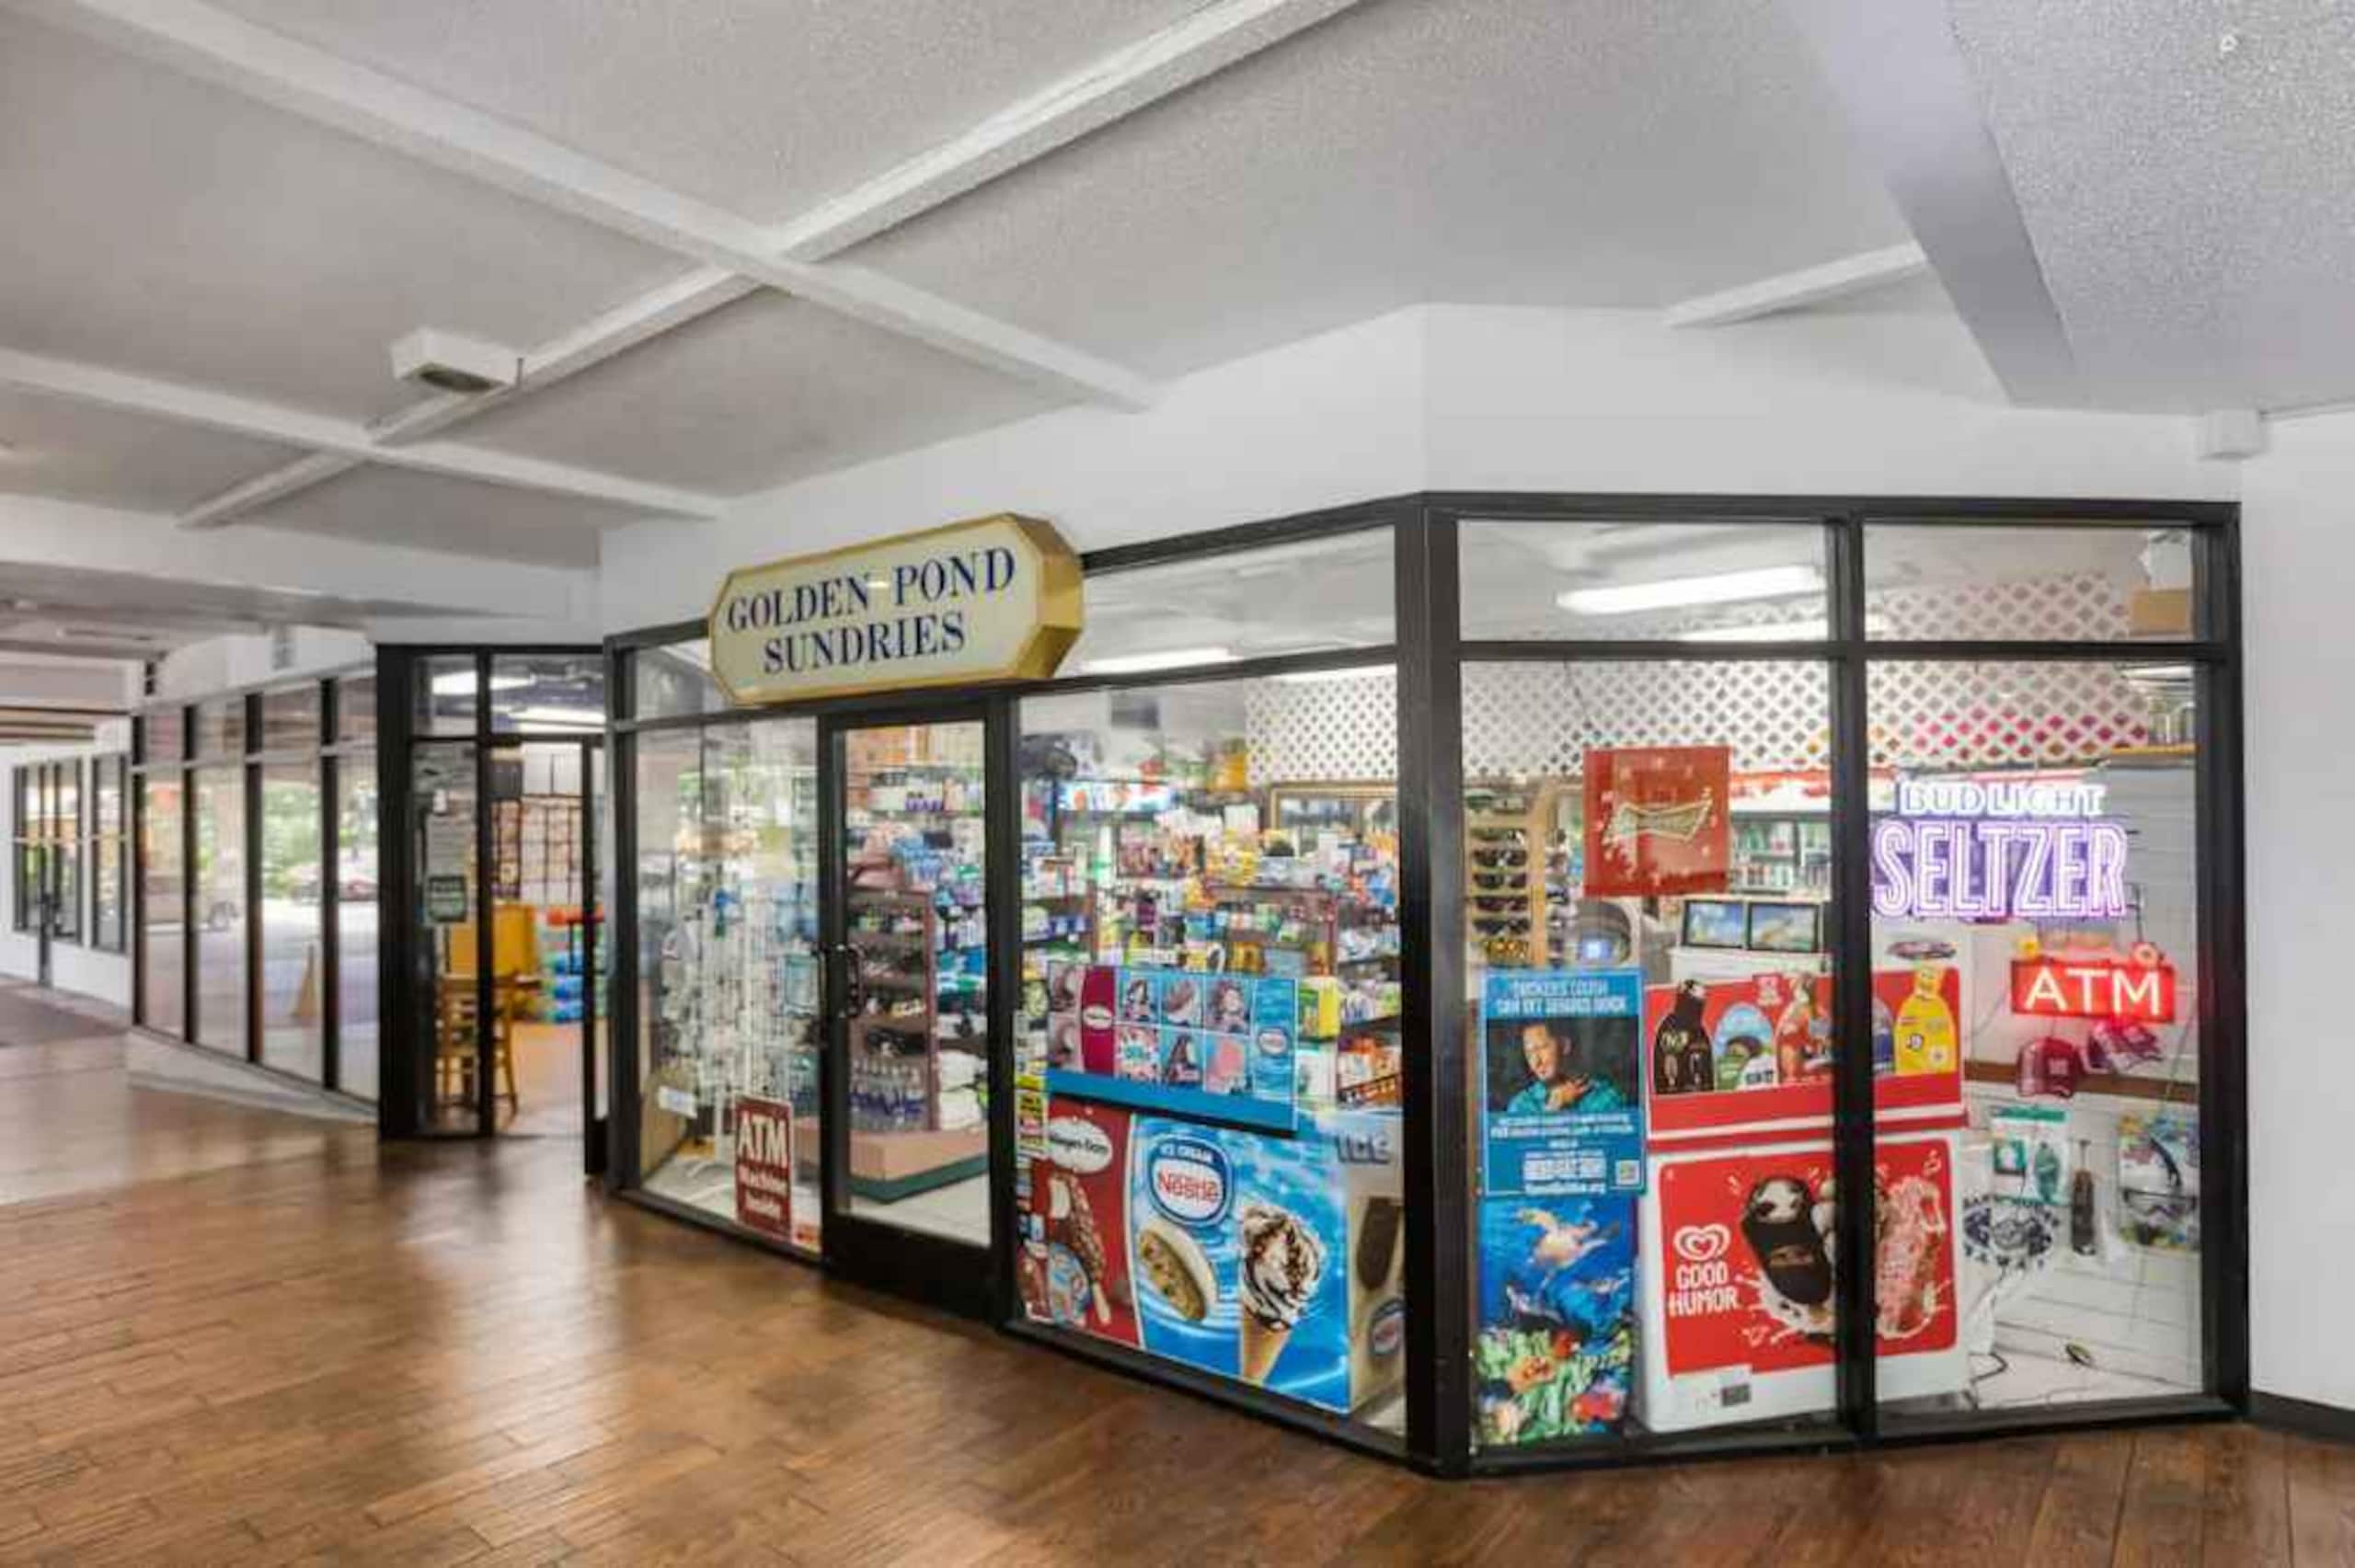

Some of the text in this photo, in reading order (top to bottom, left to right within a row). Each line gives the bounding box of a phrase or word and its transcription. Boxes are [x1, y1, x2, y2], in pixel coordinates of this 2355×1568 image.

[728, 547, 1017, 633] GOLDEN POND
[763, 611, 966, 675] SUNDRIES
[1899, 781, 2107, 817] BUD LIGHT
[1873, 818, 2129, 918] SELTZER
[2025, 967, 2162, 1016] ATM
[739, 1110, 788, 1168] ATM
[1668, 1286, 1740, 1317] HUMOR
[1675, 1261, 1729, 1289] GOOD
